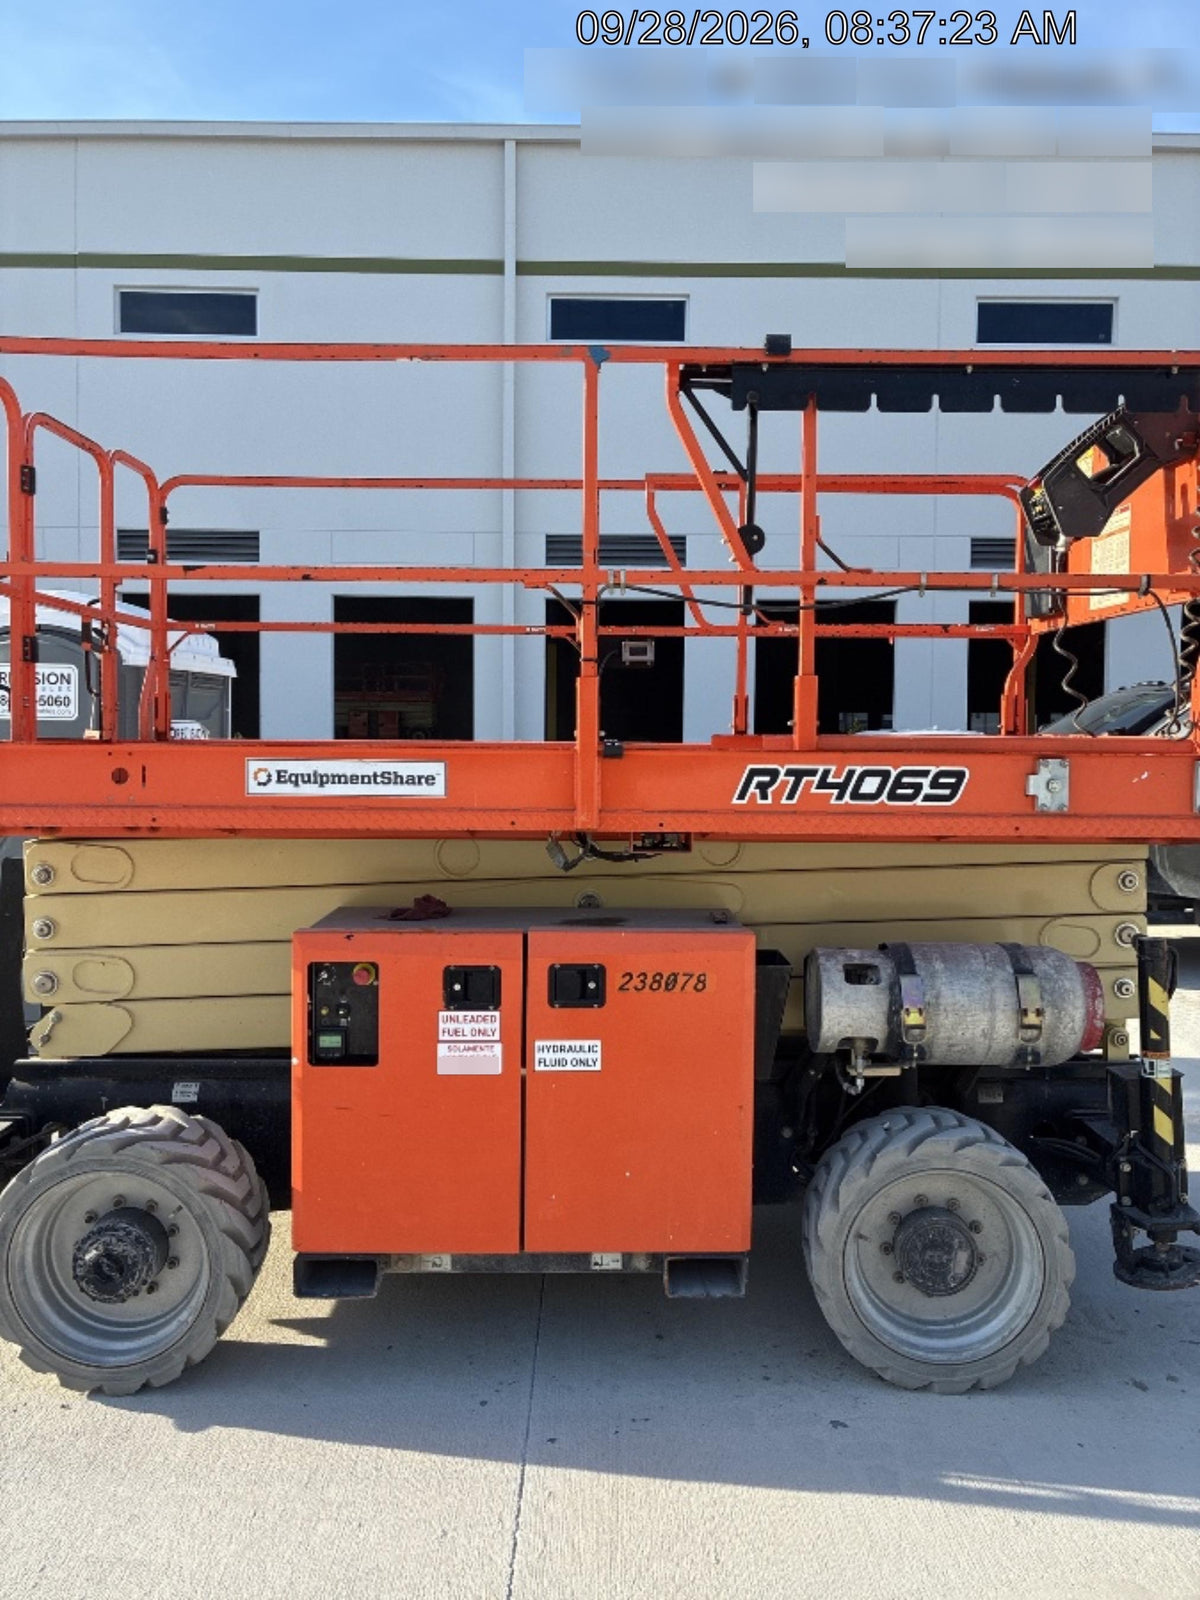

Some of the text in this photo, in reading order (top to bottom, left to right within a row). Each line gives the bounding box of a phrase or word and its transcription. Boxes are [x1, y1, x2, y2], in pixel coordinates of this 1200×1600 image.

[275, 769, 437, 787] EquipmentShare
[732, 764, 970, 806] RT4069
[618, 971, 708, 993] 238078
[441, 1014, 498, 1024] UNLEADED
[441, 1027, 497, 1038] FUEL ONLY
[536, 1044, 599, 1054] HYDRAULIC
[537, 1057, 598, 1068] FLUID ONLY
